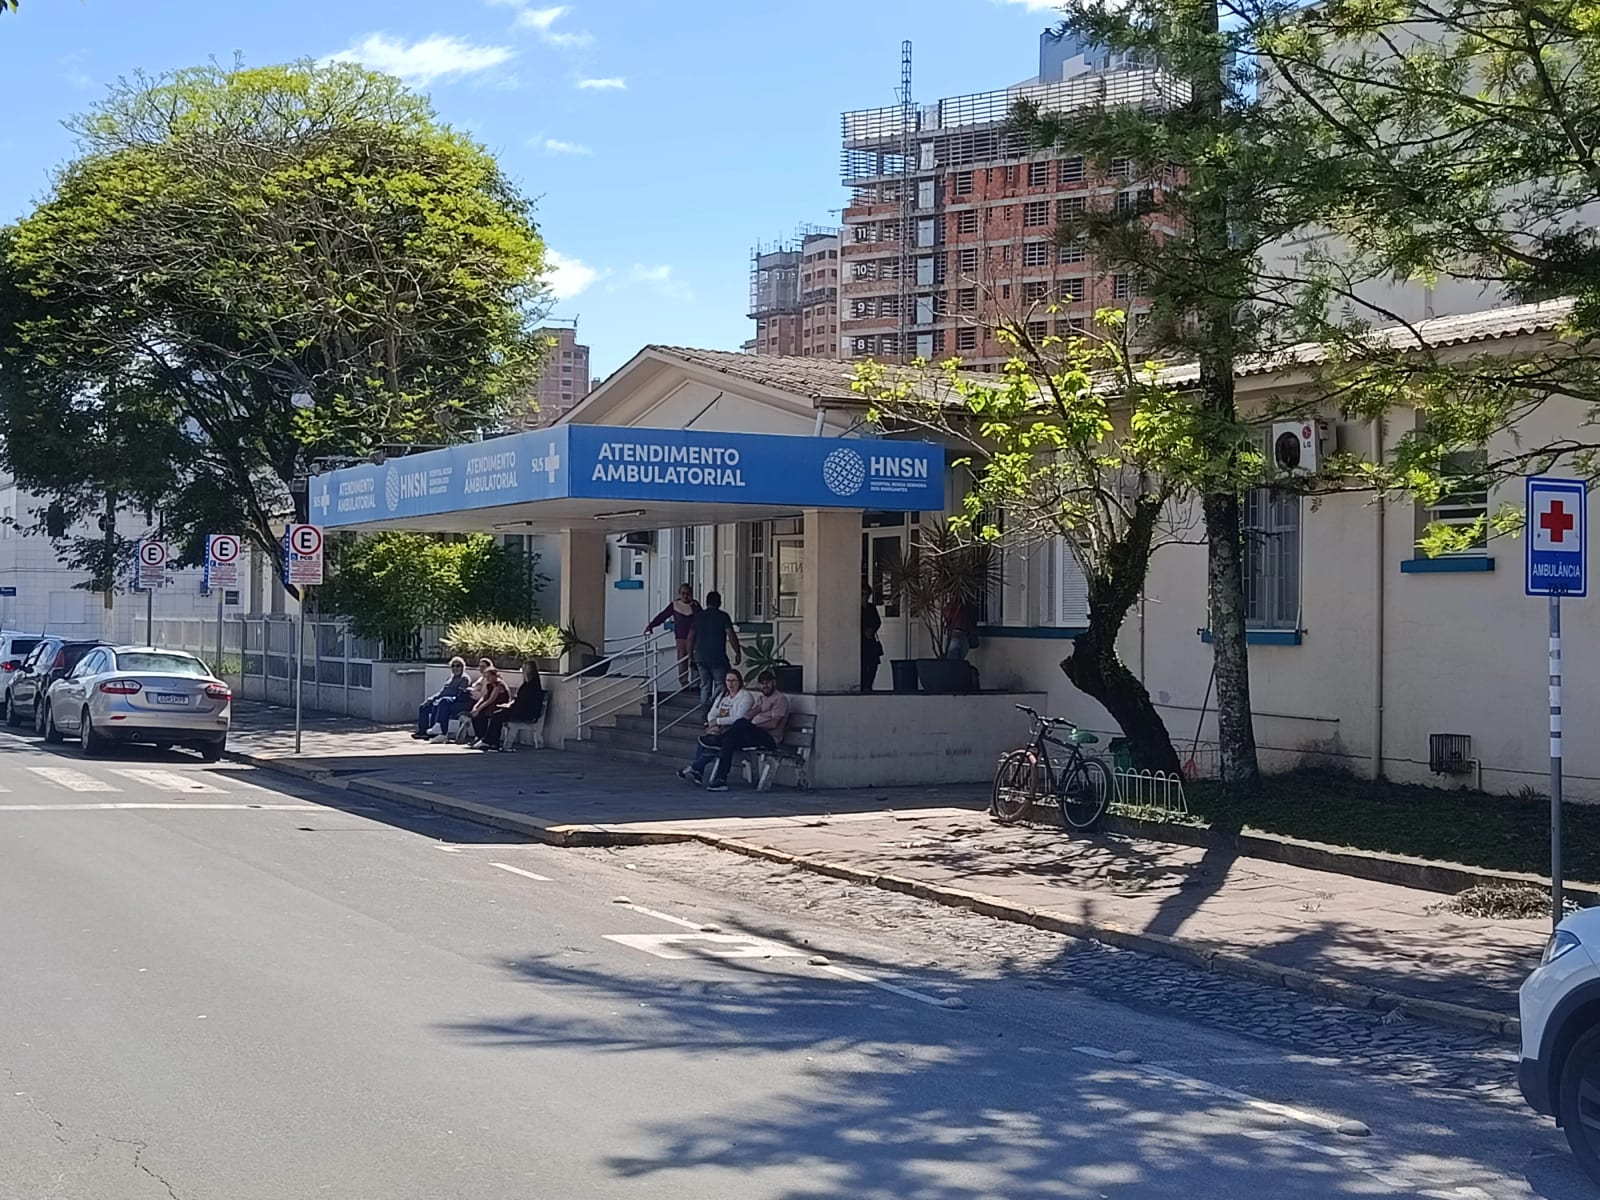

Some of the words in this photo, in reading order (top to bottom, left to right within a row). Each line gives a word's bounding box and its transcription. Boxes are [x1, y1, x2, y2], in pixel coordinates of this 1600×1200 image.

[857, 228, 867, 239] 11
[856, 264, 867, 275] 10
[857, 302, 865, 313] 9
[857, 339, 865, 350] 8
[466, 451, 516, 475] ATENDIMENTO
[598, 442, 740, 466] ATENDIMENTO
[531, 457, 544, 473] SUS
[870, 456, 928, 478] HNSN
[464, 470, 518, 494] AMBULATORIAL
[592, 463, 746, 487] AMBULATORIAL
[339, 477, 375, 497] ATENDIMENTO
[400, 471, 428, 500] HNSN
[338, 494, 376, 512] AMBULATORIAL
[219, 541, 230, 556] E
[300, 531, 312, 549] E
[147, 547, 157, 561] E
[1532, 561, 1581, 578] AMBULÂNCIA
